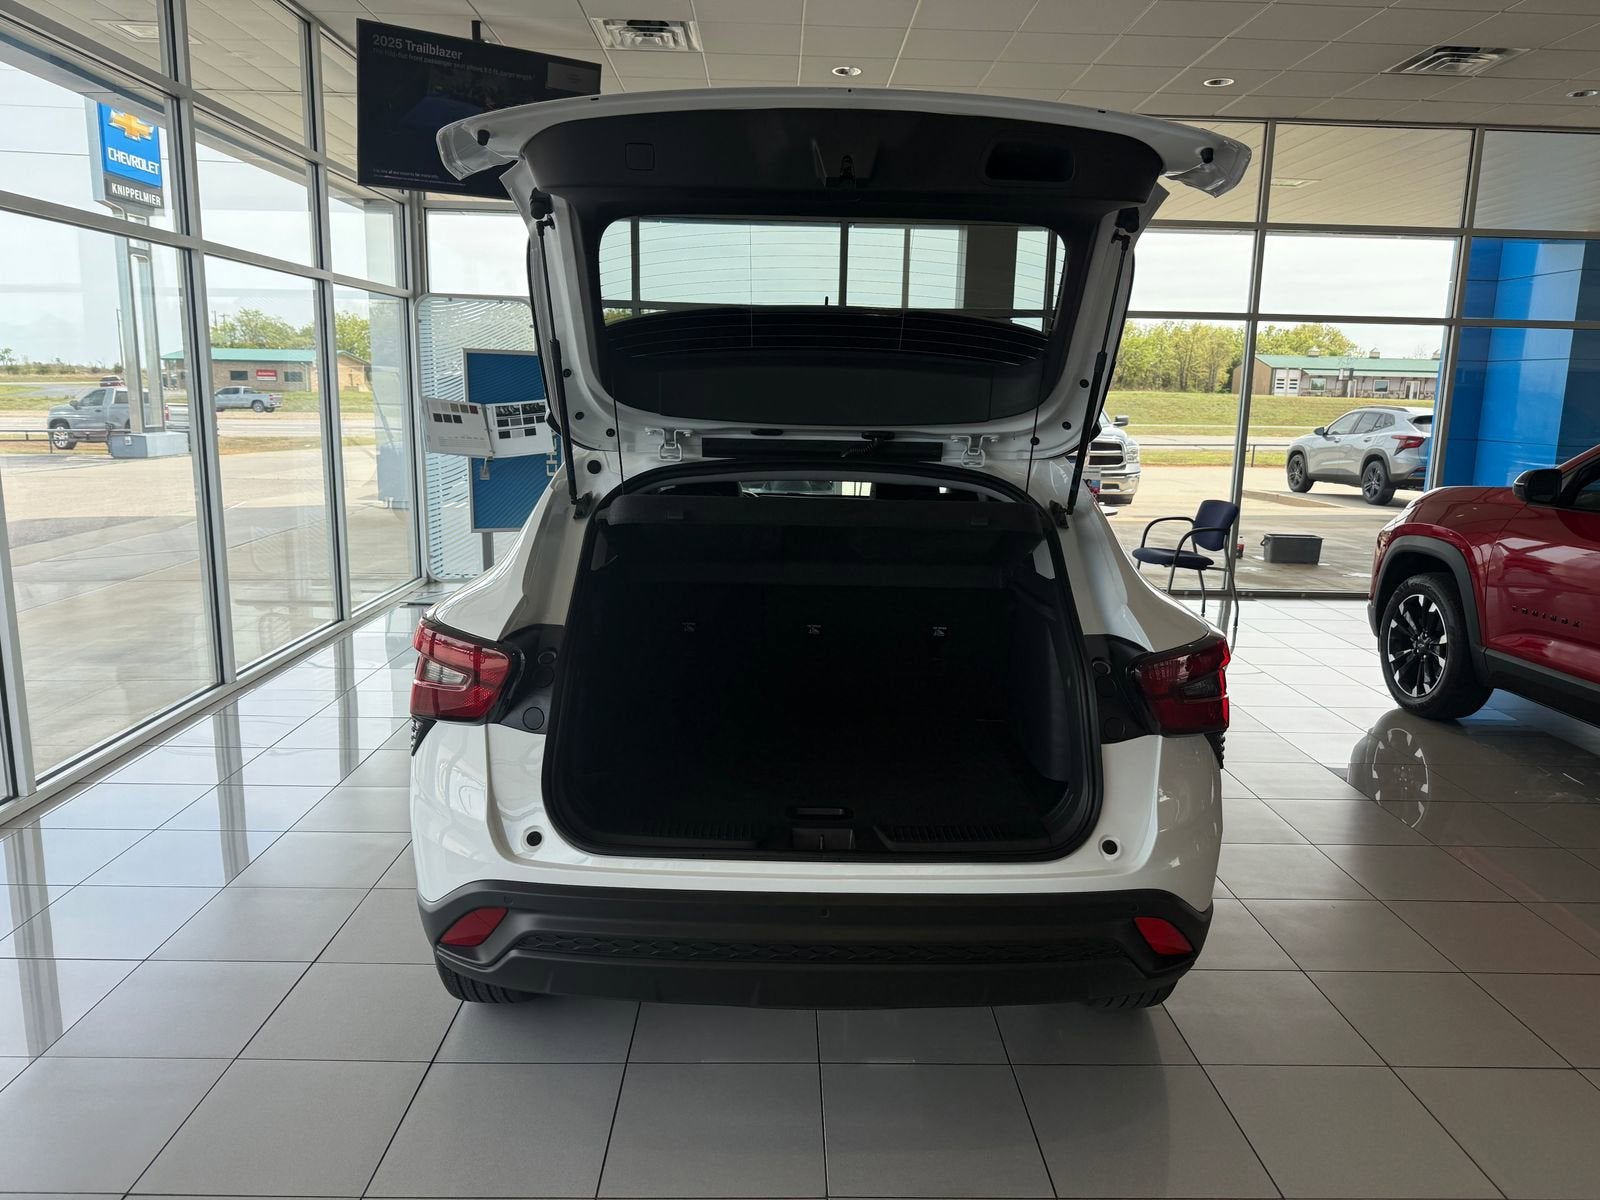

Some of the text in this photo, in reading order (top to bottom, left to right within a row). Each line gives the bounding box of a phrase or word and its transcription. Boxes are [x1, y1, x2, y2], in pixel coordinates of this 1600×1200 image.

[372, 33, 403, 50] 2025
[405, 39, 463, 60] Trailblazer
[107, 146, 159, 175] CHEVROLET
[111, 182, 161, 206] KNIPPELMIER
